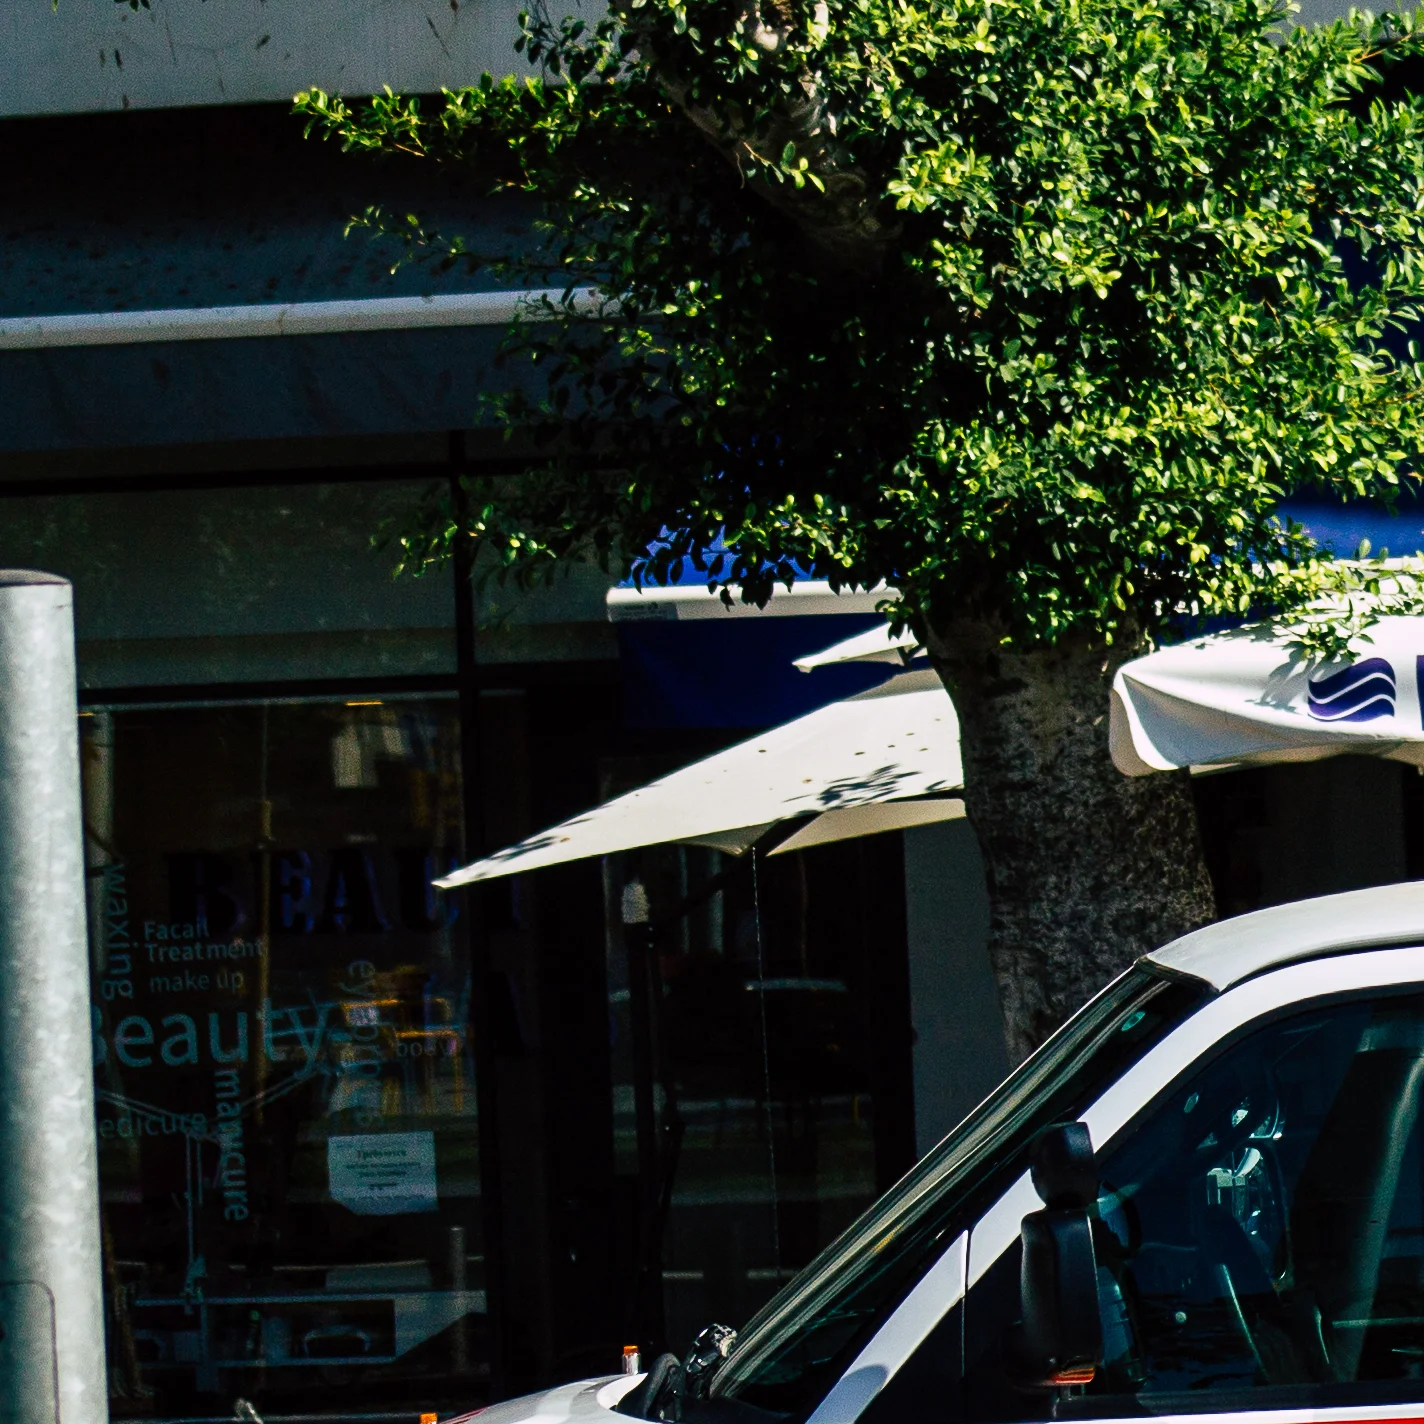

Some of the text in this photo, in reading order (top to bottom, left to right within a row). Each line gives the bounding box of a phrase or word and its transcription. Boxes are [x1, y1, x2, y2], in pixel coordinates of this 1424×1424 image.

[101, 863, 139, 1001] waxing
[143, 940, 264, 964] Treatment
[149, 968, 245, 995] make up
[98, 1108, 208, 1139] edicure
